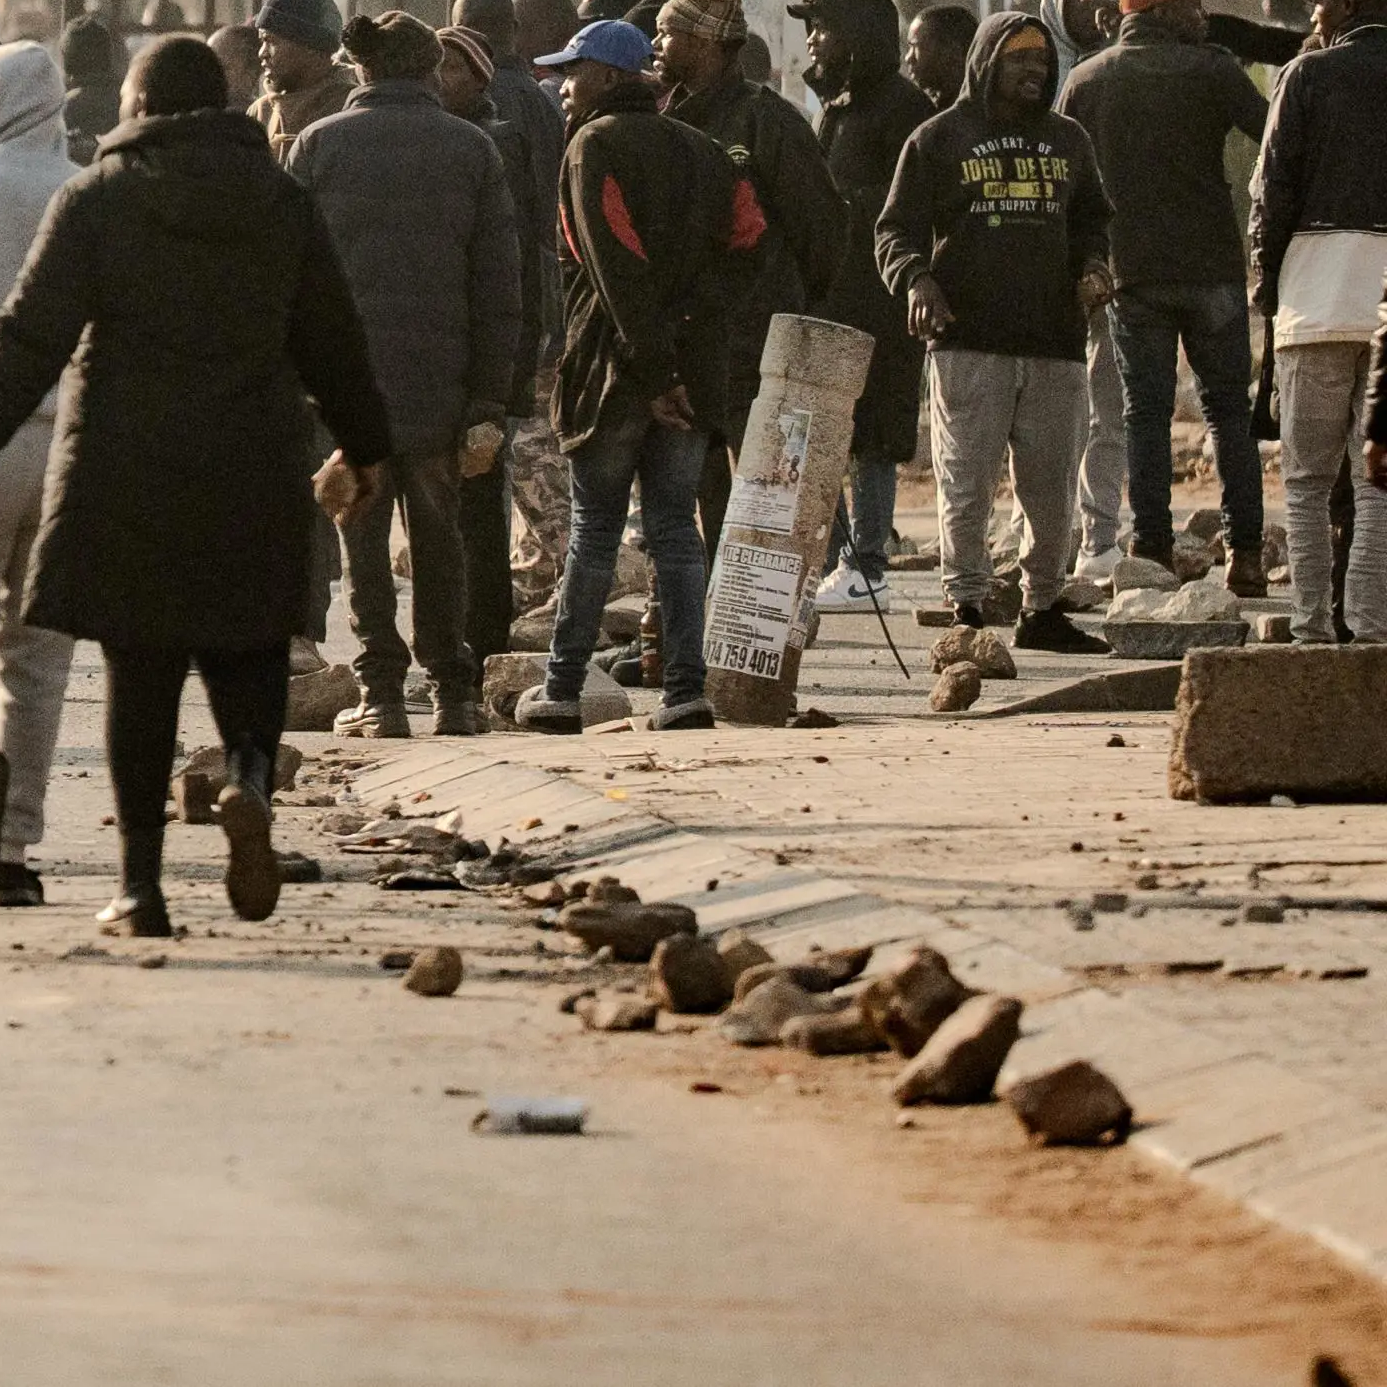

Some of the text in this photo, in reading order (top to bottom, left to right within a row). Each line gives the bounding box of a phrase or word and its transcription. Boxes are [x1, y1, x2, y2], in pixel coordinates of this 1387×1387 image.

[1038, 142, 1052, 155] OF
[1000, 200, 1036, 212] SUPPLY
[740, 548, 801, 574] CLEARANCE
[724, 643, 748, 670] 759
[748, 648, 780, 677] 4013
